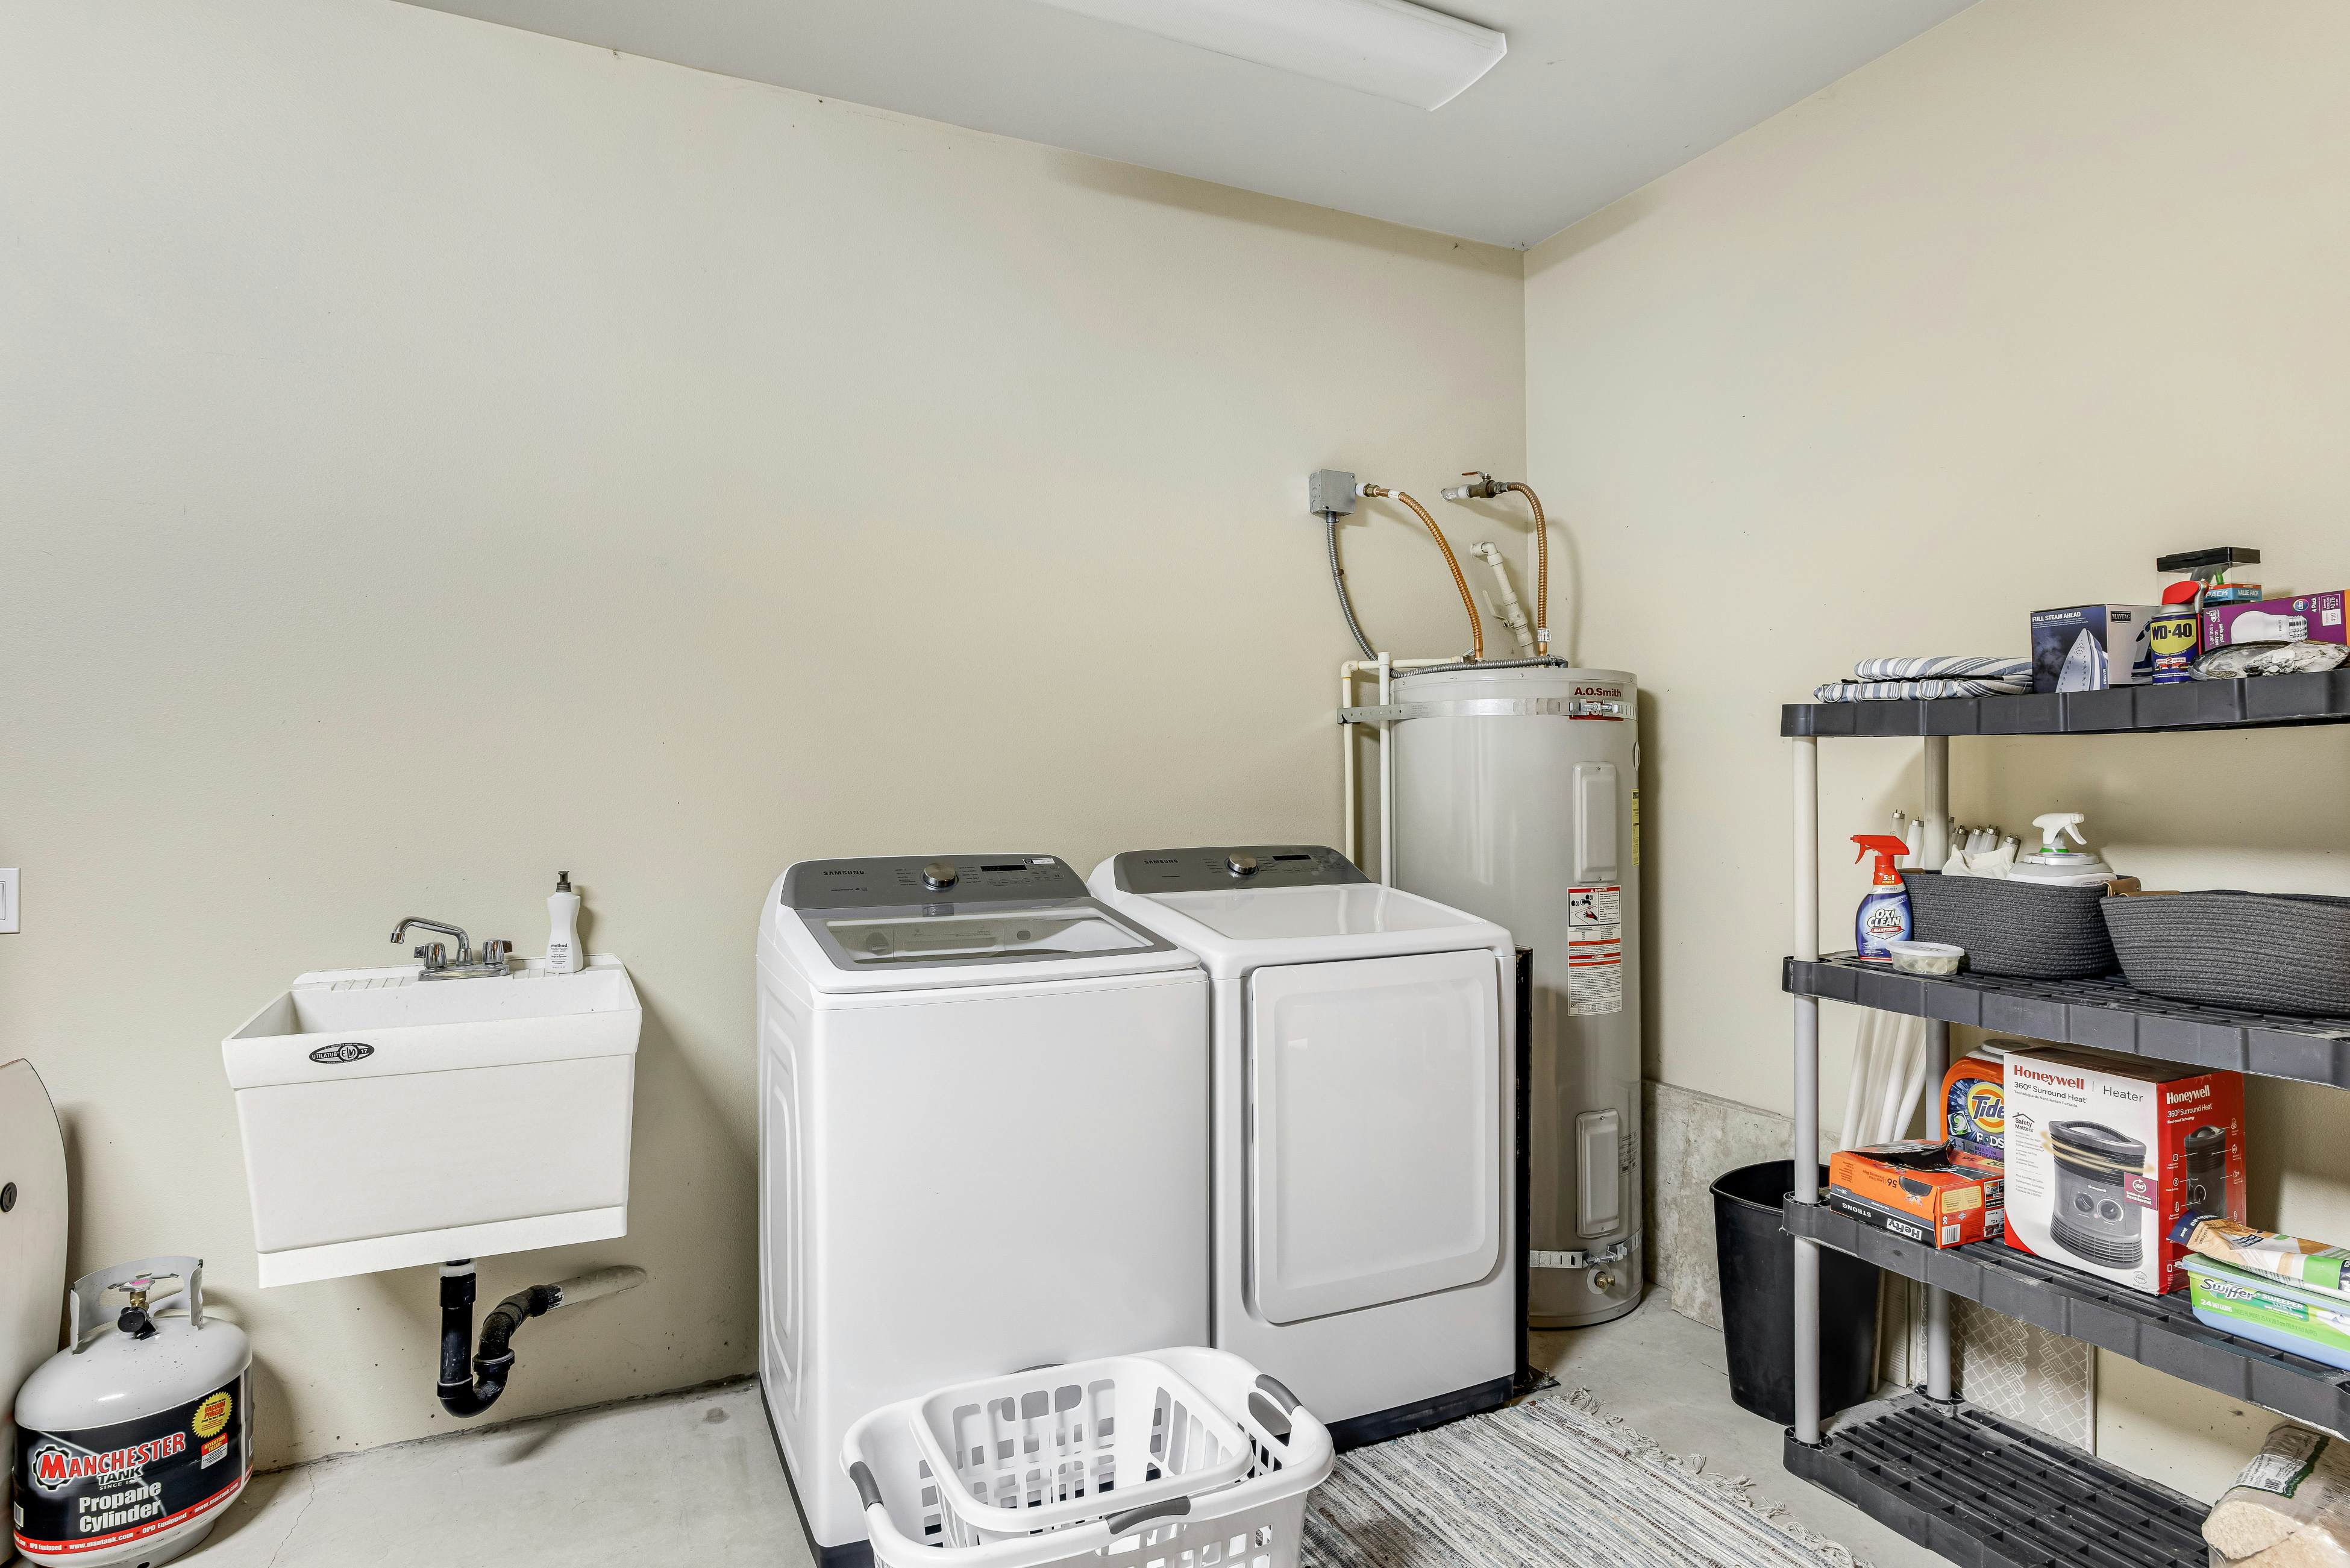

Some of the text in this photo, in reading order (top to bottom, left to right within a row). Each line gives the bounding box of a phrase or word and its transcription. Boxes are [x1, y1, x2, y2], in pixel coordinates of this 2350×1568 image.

[2152, 623, 2192, 641] WD-40
[1867, 916, 1901, 927] CLEAN
[1875, 909, 1896, 919] OXI
[2014, 1065, 2144, 1102] Honeywell Heater
[2014, 1082, 2087, 1103] 360° Surround Heat
[2166, 1085, 2210, 1105] Honeywell
[1972, 1096, 2004, 1120] Tide
[2180, 1105, 2201, 1115] Surround
[2015, 1117, 2032, 1127] Safety
[2015, 1123, 2033, 1132] Matters
[1975, 1144, 1997, 1155] BUILT-IN
[1887, 1178, 1897, 1188] 56
[2126, 1194, 2152, 1205] Ambiental
[1842, 1203, 1872, 1217] STRONG
[1888, 1219, 1920, 1239] Hefty
[2200, 1279, 2255, 1300] Swiffer
[2201, 1299, 2212, 1307] 24
[2261, 1294, 2304, 1310] SWEEPER
[204, 1400, 226, 1413] VACUUM
[204, 1408, 224, 1420] PURGED
[40, 1432, 186, 1479] MANCHESTER
[98, 1466, 143, 1486] TANK
[80, 1482, 162, 1513] Propane
[69, 1532, 134, 1550] www.mantank.com
[142, 1525, 155, 1534] OPD
[157, 1513, 187, 1529] Equipped
[194, 1482, 239, 1513] www.mantank.com
[80, 1499, 162, 1532] Cylinder
